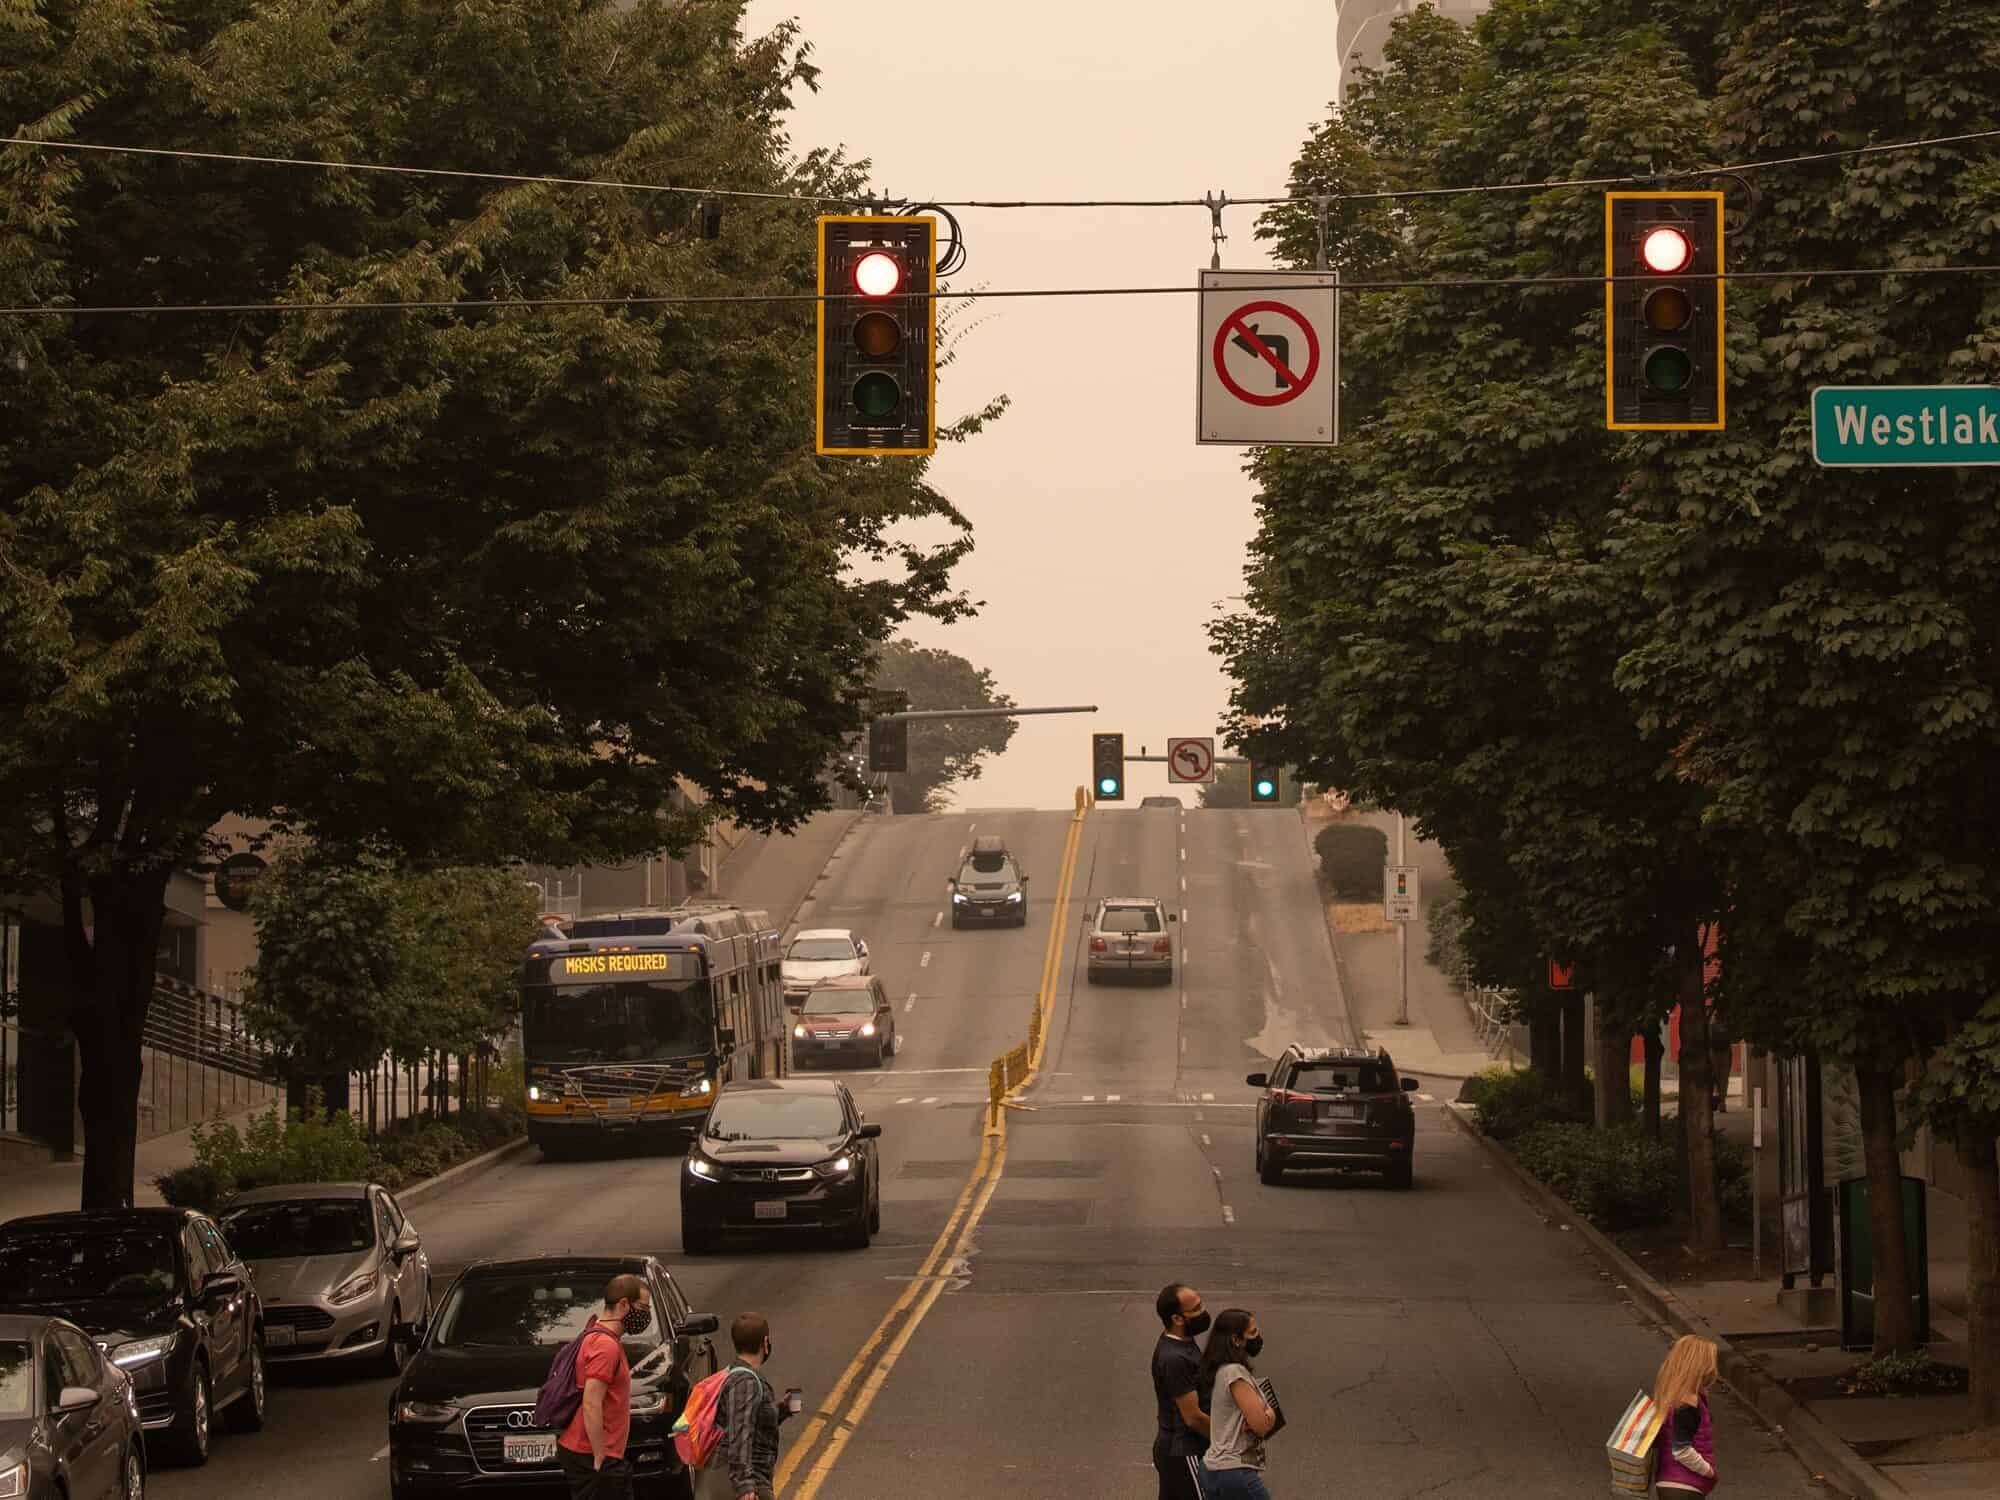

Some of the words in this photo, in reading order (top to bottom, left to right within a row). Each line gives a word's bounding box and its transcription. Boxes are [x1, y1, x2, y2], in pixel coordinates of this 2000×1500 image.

[1833, 404, 2000, 446] Westlak
[566, 956, 606, 974] MASKS
[608, 953, 667, 972] REQUIRED
